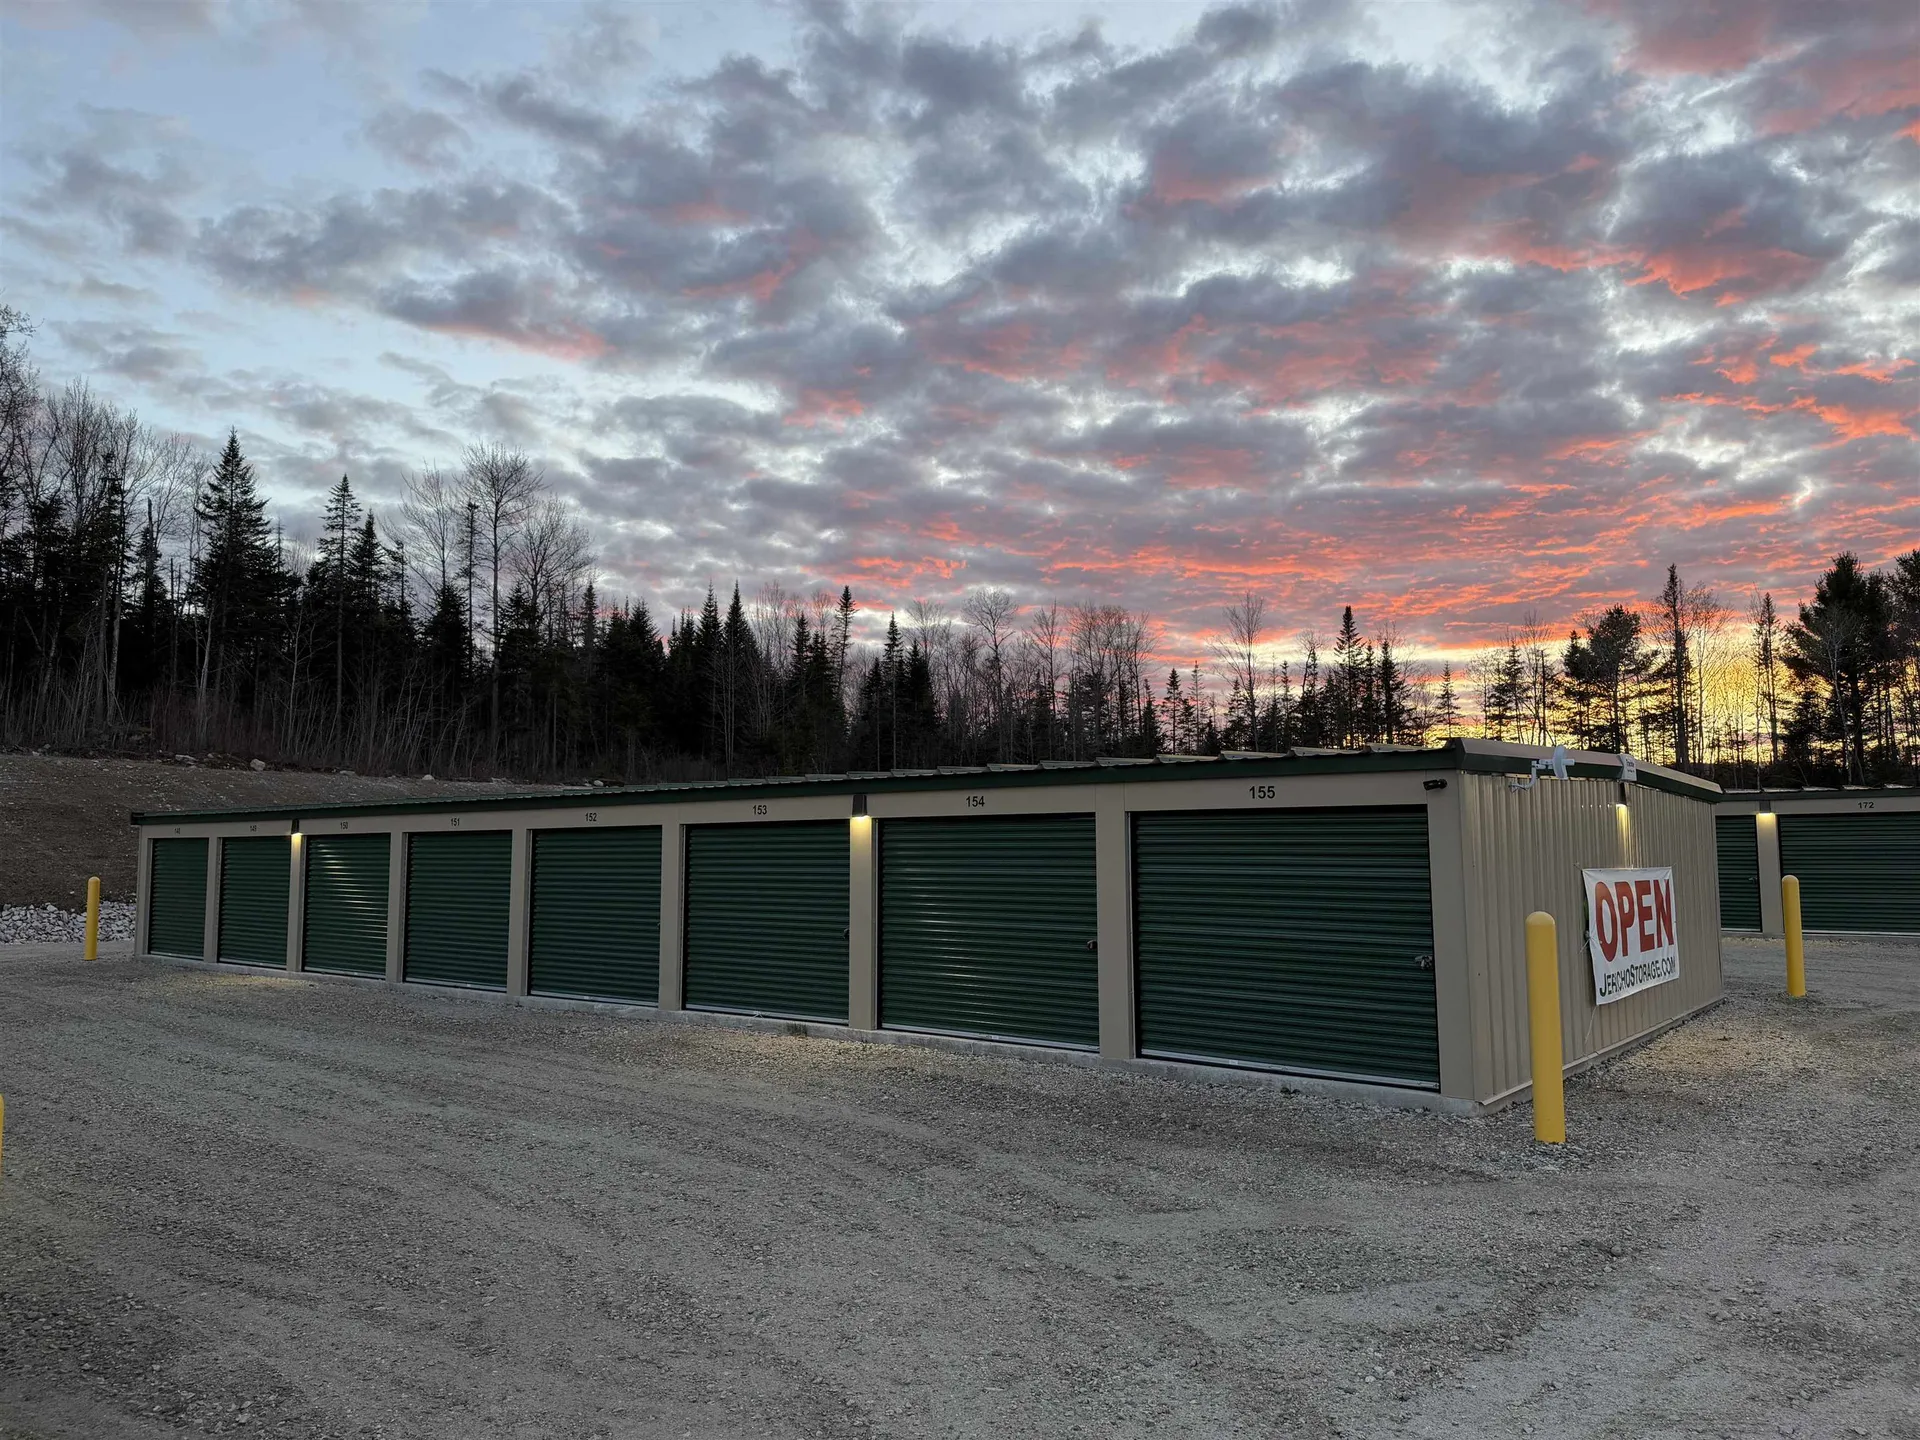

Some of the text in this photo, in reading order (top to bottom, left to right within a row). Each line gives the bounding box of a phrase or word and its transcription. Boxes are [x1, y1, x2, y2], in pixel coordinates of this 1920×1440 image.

[1249, 785, 1276, 800] 155
[965, 795, 986, 808] 154
[1857, 801, 1875, 810] 172
[752, 804, 768, 816] 153
[450, 817, 460, 827] 151
[585, 812, 598, 822] 152
[1594, 878, 1675, 963] OPEN
